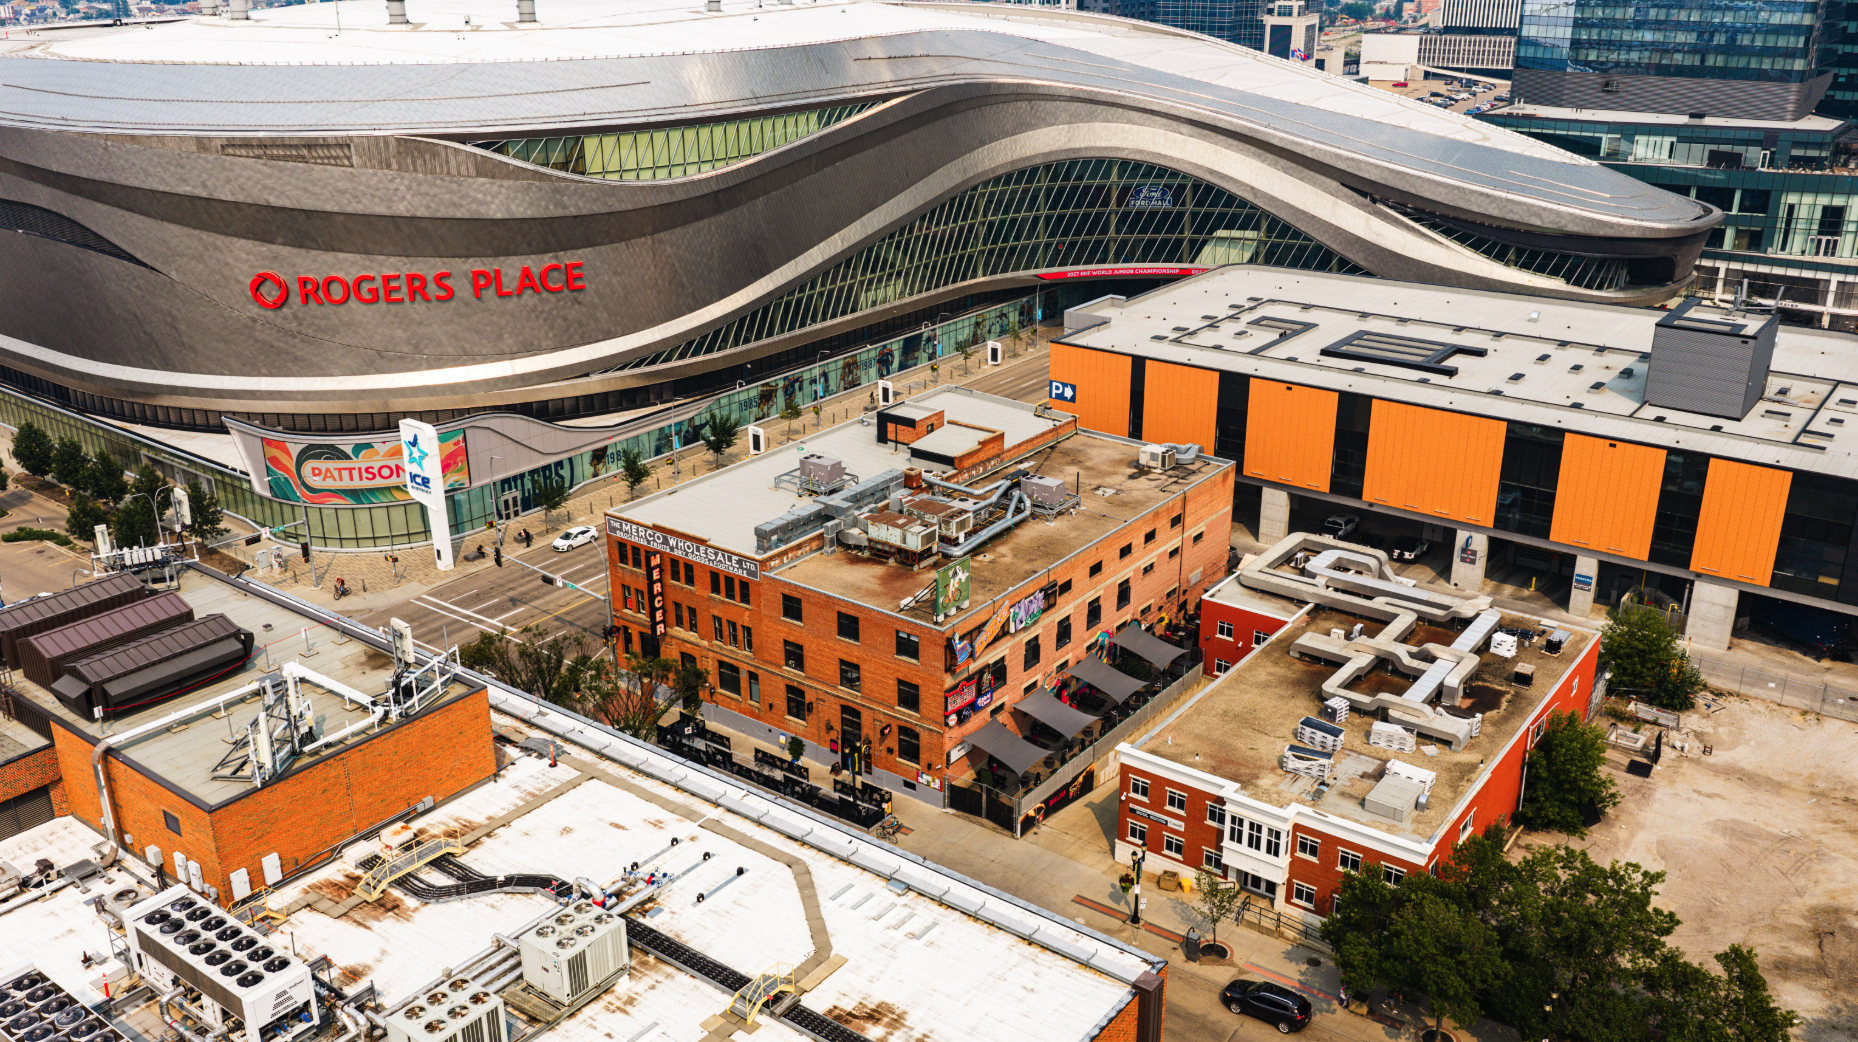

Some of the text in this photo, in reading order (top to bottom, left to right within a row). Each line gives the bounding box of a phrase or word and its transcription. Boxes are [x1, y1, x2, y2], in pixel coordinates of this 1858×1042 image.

[297, 261, 586, 305] ROGERS PLACE
[861, 357, 876, 371] 1987
[740, 397, 758, 413] 1985
[1052, 381, 1063, 398] P
[610, 521, 757, 572] THE MERCO WHOLESALE LTD.
[616, 530, 648, 546] GROCERIES
[650, 541, 670, 553] FRUITS
[673, 548, 687, 558] DRY
[687, 553, 709, 564] GOODS
[650, 553, 666, 636] MERCER
